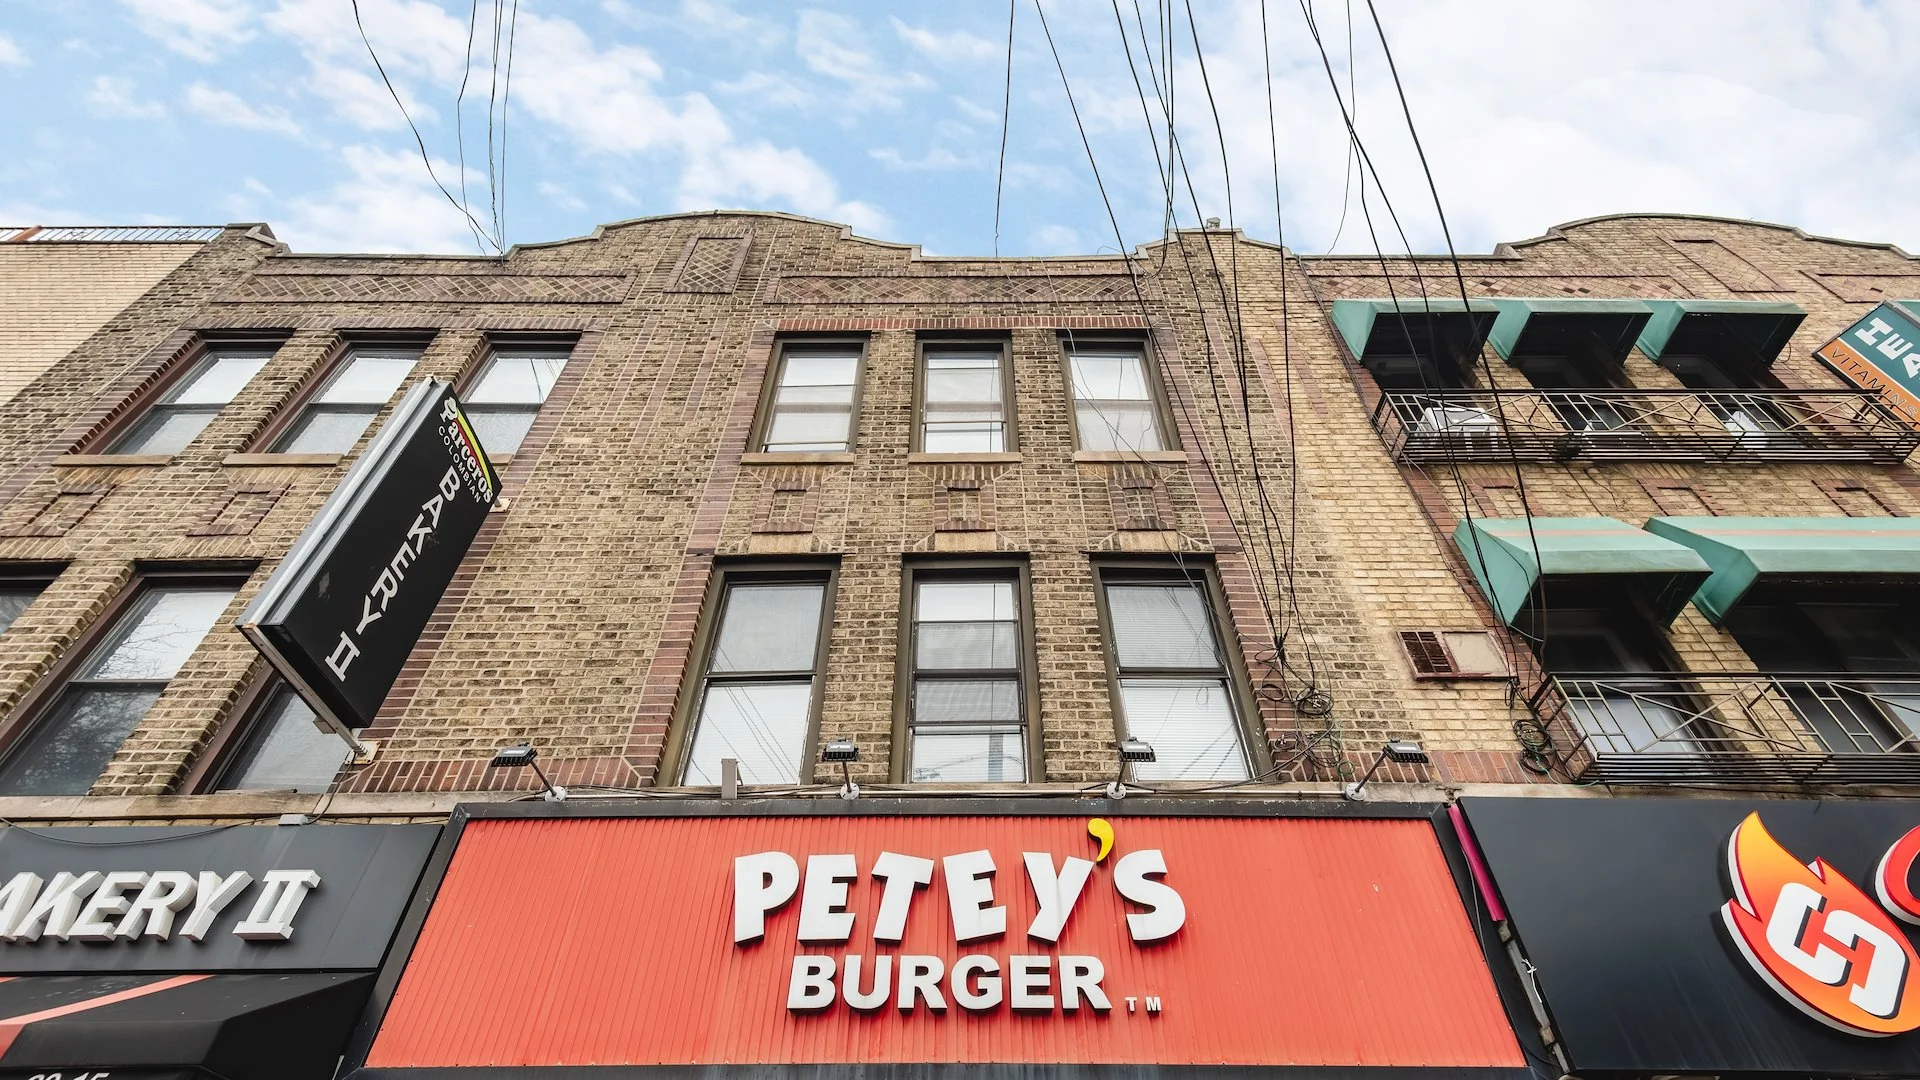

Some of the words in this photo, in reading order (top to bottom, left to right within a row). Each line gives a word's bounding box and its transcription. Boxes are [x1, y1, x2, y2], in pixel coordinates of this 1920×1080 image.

[1832, 346, 1917, 417] VITAMINS
[438, 426, 481, 503] COLOMBIAN
[440, 397, 493, 503] Parceros
[355, 465, 461, 635] BAKERY
[324, 631, 361, 682] II
[0, 870, 254, 942] AKERY
[232, 869, 322, 940] II
[734, 818, 1187, 943] PETEY'S
[787, 954, 1112, 1011] BURGER
[1124, 996, 1163, 1013] TM
